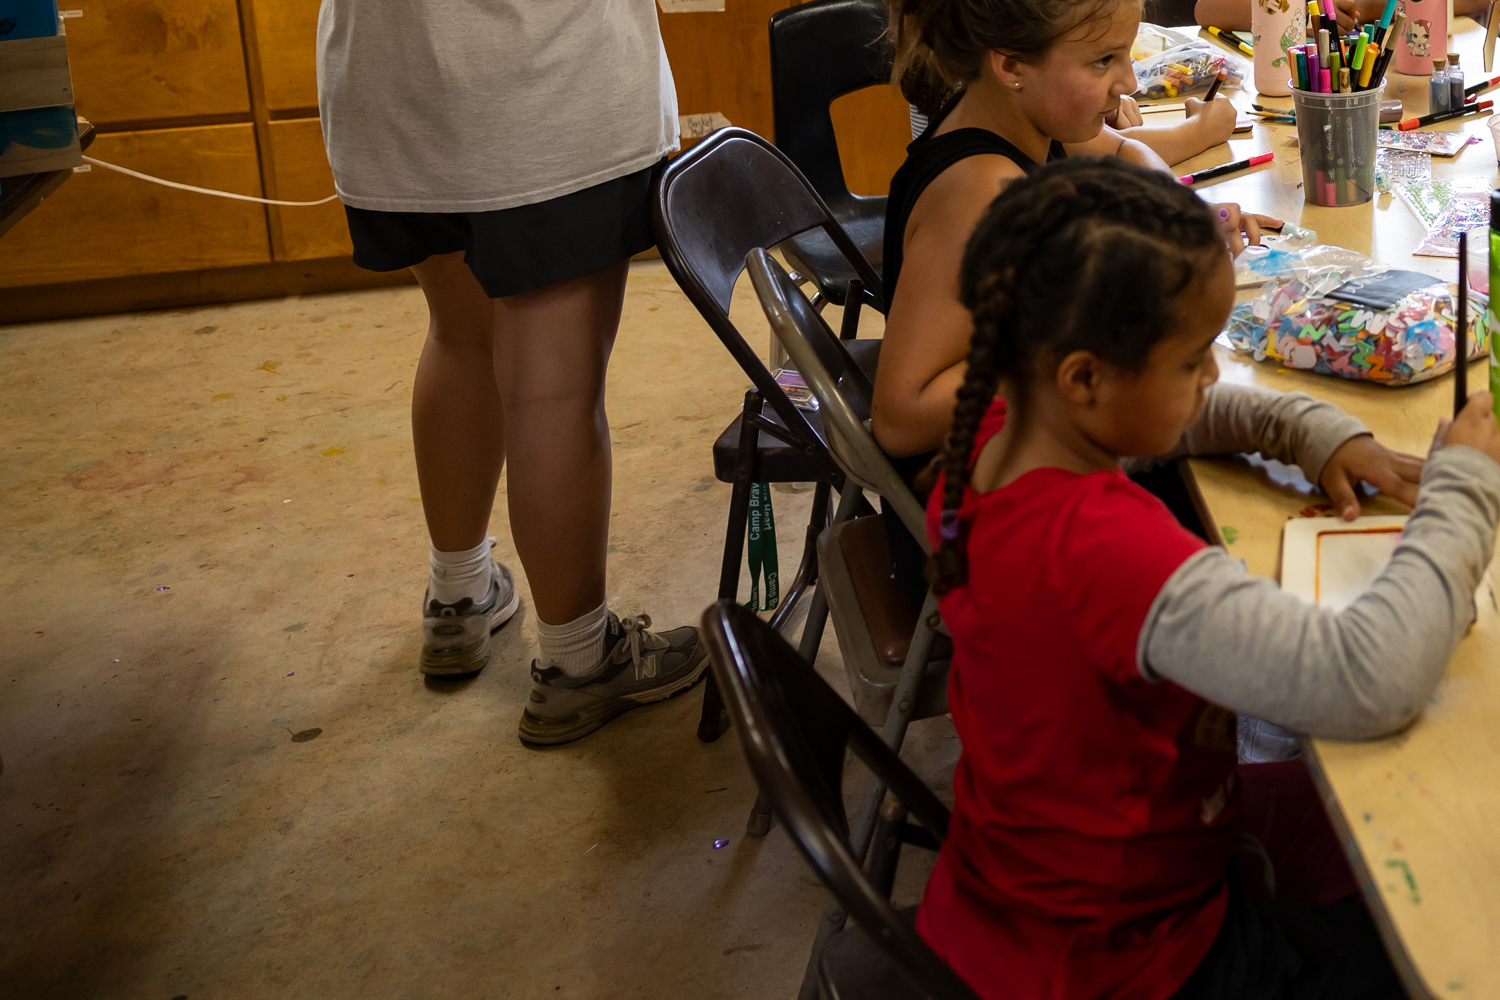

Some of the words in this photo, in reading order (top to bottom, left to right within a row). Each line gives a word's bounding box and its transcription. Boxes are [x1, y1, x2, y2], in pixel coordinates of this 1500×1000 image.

[749, 482, 761, 507] Brav
[749, 510, 762, 541] Camp
[768, 572, 778, 598] Camp
